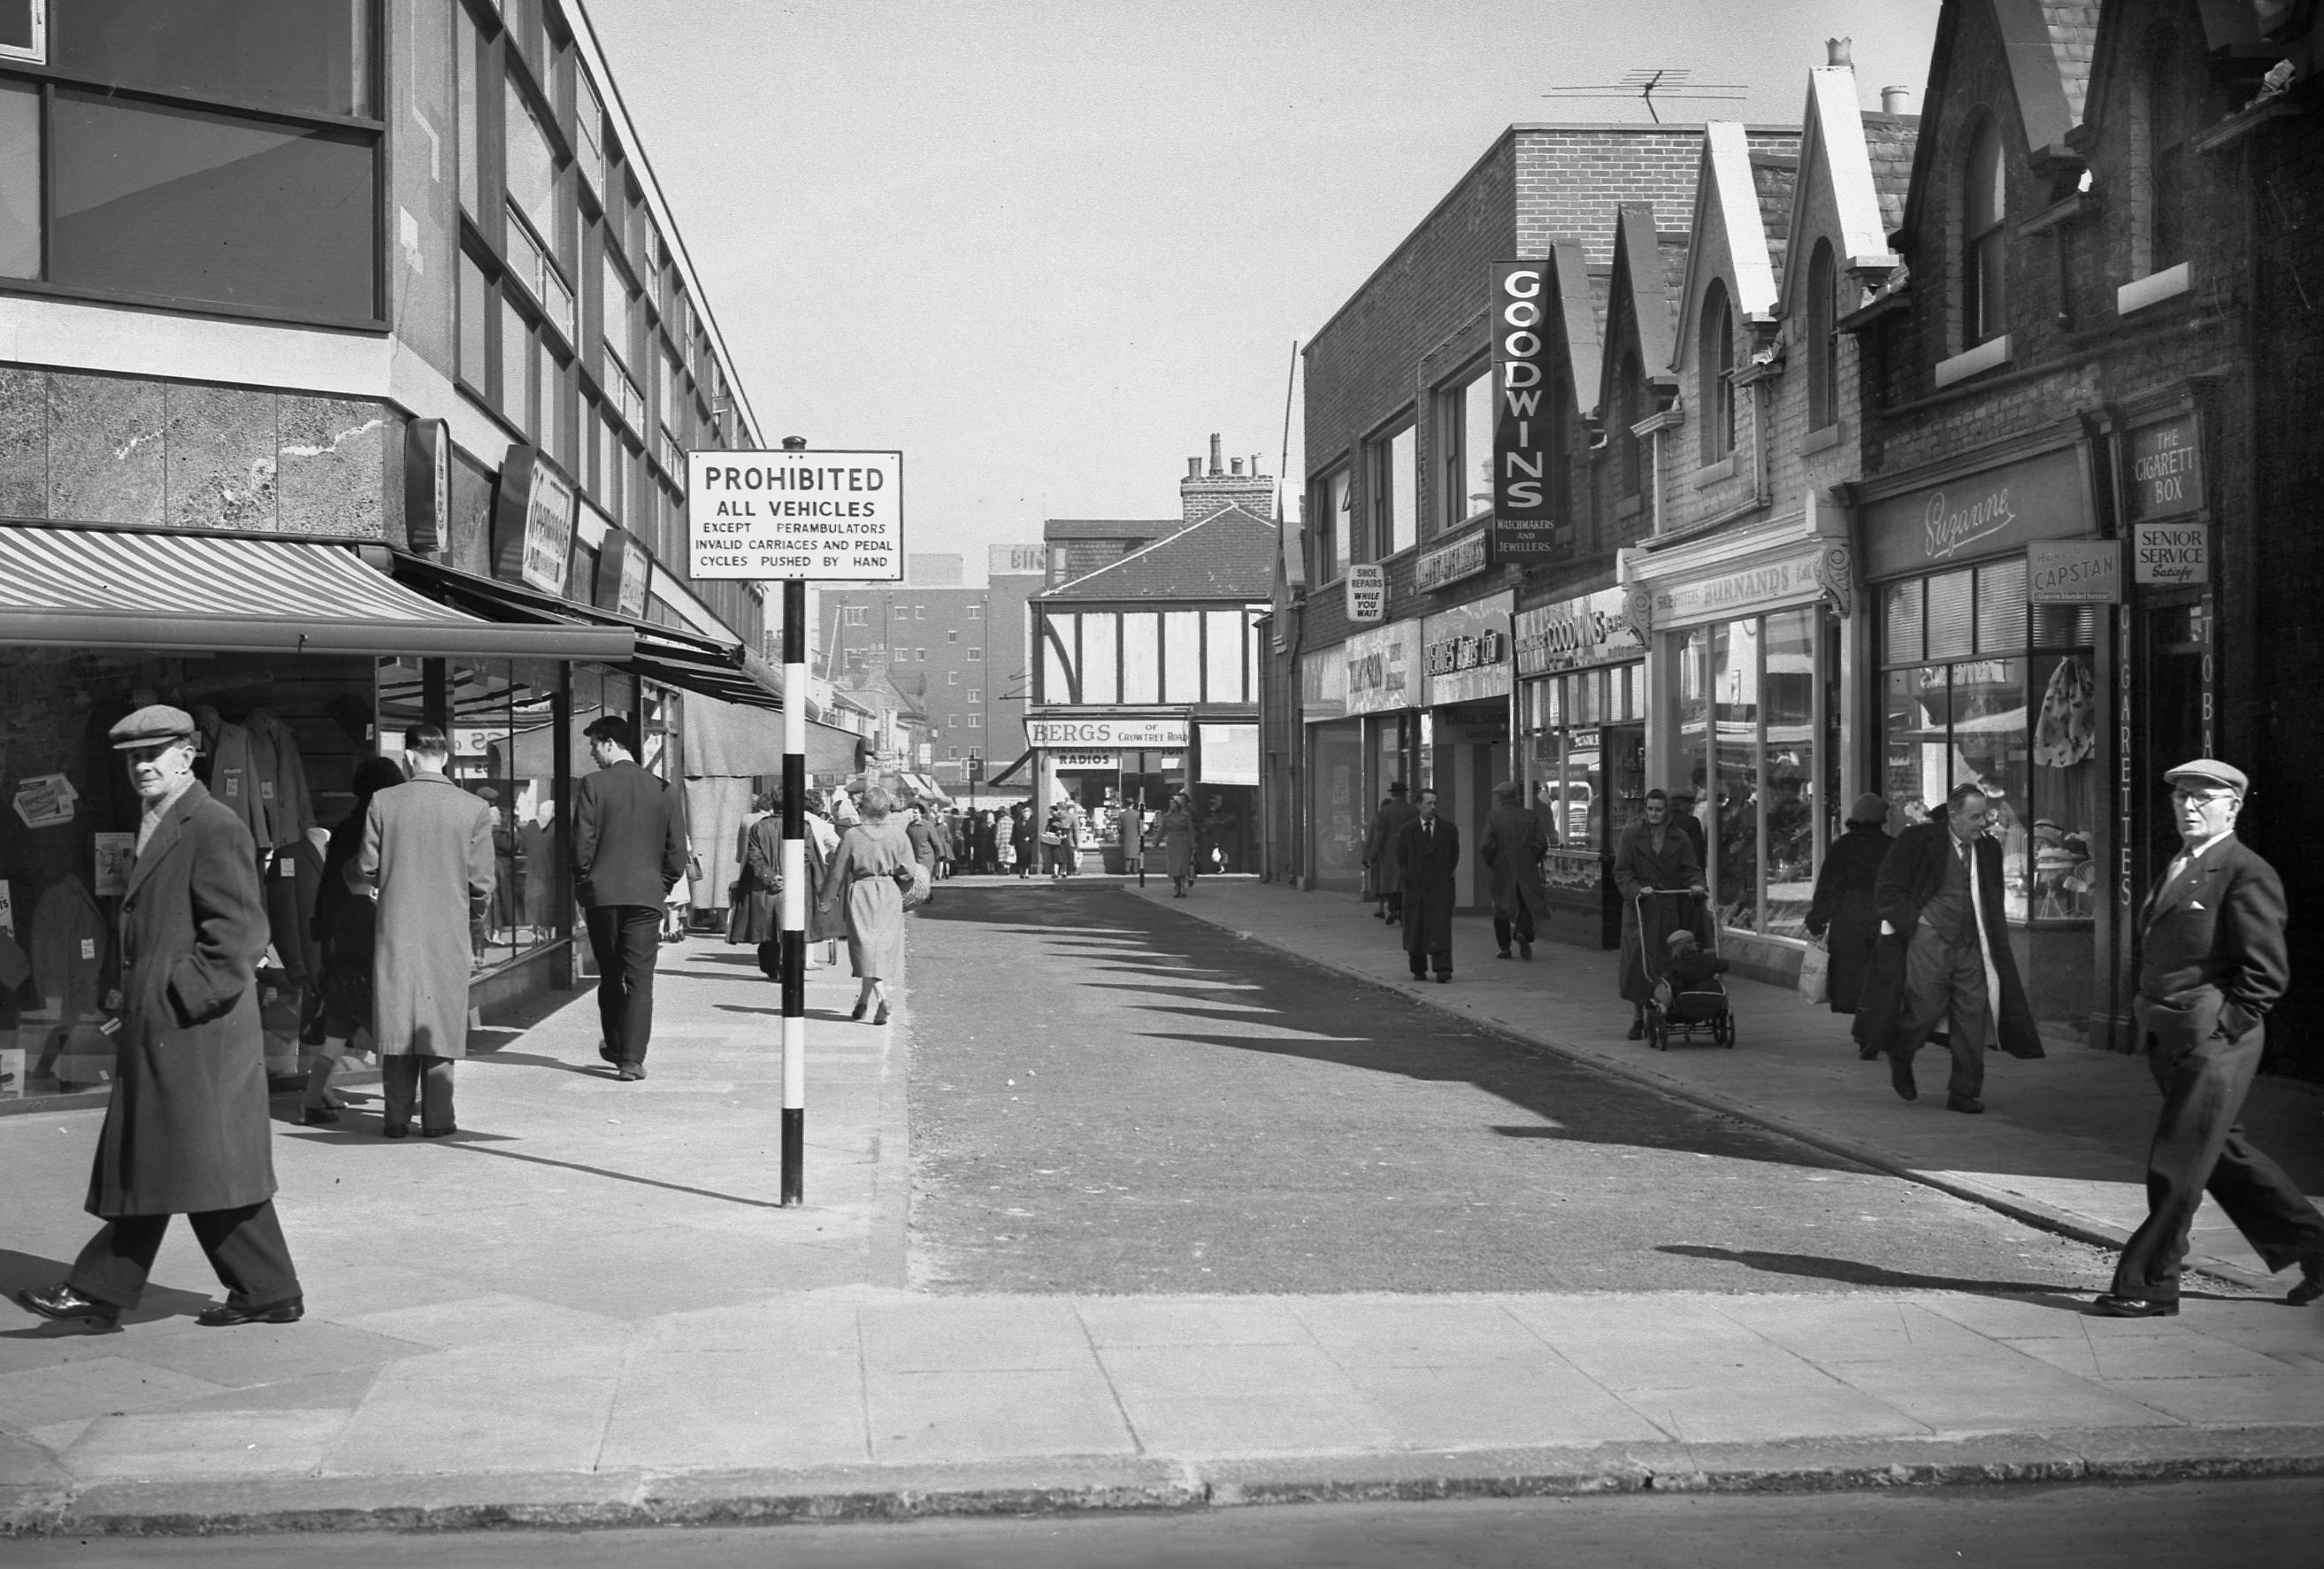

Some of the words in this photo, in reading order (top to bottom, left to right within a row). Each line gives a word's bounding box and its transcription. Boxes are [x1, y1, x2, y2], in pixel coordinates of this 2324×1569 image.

[1504, 270, 1543, 509] GOODWINS
[2156, 428, 2179, 448] THE
[705, 466, 884, 491] PROHIBITED
[2154, 476, 2182, 504] BOX
[717, 500, 756, 517] ALL
[769, 501, 876, 518] VEHICLES
[703, 522, 752, 534] EXCEPT
[777, 523, 886, 535] PERAMBULATORS
[1497, 519, 1553, 530] WATCHMAKERS
[1925, 488, 2015, 558] Suzanne
[695, 539, 743, 550] INVALID
[748, 540, 818, 550] CARRIAGES
[823, 540, 849, 550] AND
[855, 541, 894, 551] PEDAL
[2142, 530, 2202, 546] SENIOR
[700, 556, 748, 566] CYCLES
[761, 556, 811, 566] PUSHED
[823, 556, 839, 566] BY
[853, 557, 888, 567] HAND
[2037, 550, 2068, 563] Have
[2139, 548, 2204, 564] SERVICE
[1356, 568, 1377, 578] SHOE
[2035, 555, 2113, 590] CAPSTAN
[2151, 564, 2194, 582] Satisfy
[1351, 579, 1384, 588] REPAIRS
[1354, 592, 1380, 601] WHILE
[1356, 609, 1379, 618] WAIT
[2201, 616, 2213, 758] TOBA
[1032, 724, 1111, 742] BERGS
[1117, 731, 1164, 742] CROWTREE
[1058, 754, 1110, 765] RADIOS
[2119, 604, 2132, 905] CIGARETTES
[967, 760, 978, 780] P
